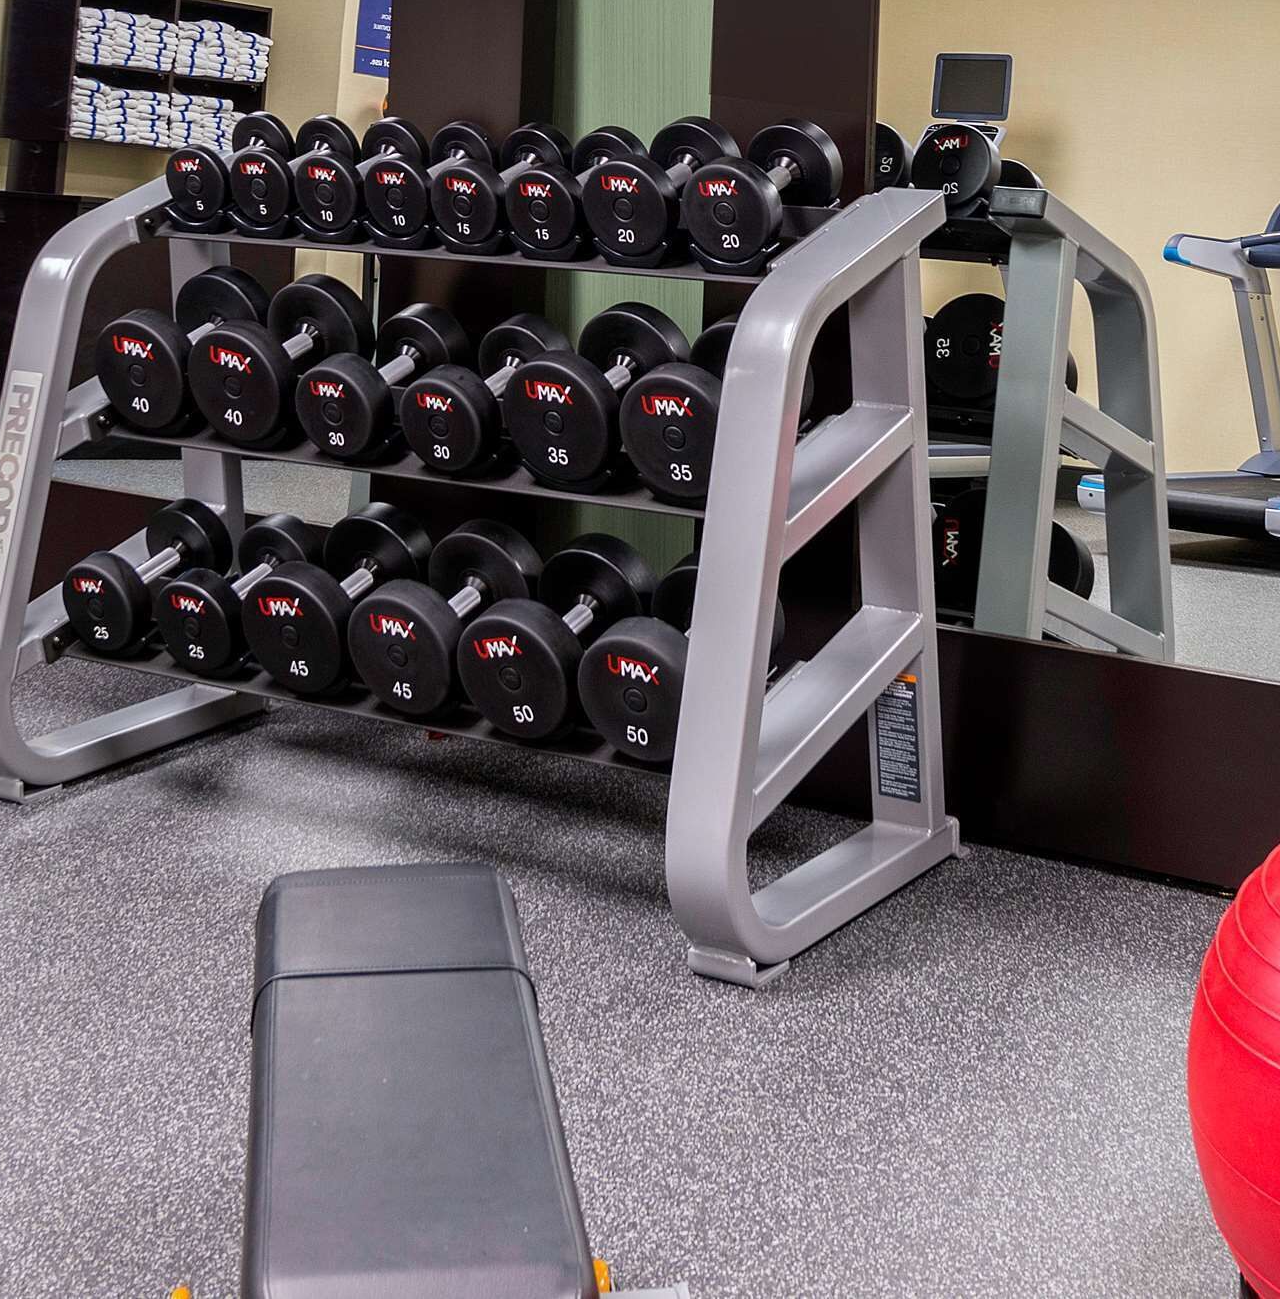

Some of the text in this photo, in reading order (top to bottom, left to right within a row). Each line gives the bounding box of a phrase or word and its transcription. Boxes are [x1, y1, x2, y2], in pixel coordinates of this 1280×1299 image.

[307, 166, 337, 183] UMAX
[375, 171, 407, 185] UMAX
[444, 177, 478, 197] UMAX
[519, 182, 552, 199] UMAX
[600, 174, 641, 195] UMAX
[697, 178, 739, 198] UMAX
[195, 200, 205, 212] 5
[259, 204, 268, 216] 5
[319, 209, 334, 222] 10
[391, 214, 406, 227] 10
[456, 221, 471, 236] 15
[534, 227, 550, 241] 15
[617, 228, 635, 244] 20
[721, 233, 740, 249] 20
[111, 334, 156, 361] UMAX
[209, 344, 253, 375] UMAX
[309, 380, 346, 398] UMAX
[524, 379, 574, 406] UMAX
[131, 396, 150, 413] 40
[415, 392, 454, 413] UMAX
[640, 394, 695, 418] UMAX
[223, 408, 243, 426] 40
[328, 431, 345, 447] 30
[432, 444, 450, 460] 30
[547, 446, 569, 466] 35
[669, 463, 693, 482] 35
[71, 577, 105, 595] UMAX
[170, 593, 207, 616] UMAX
[257, 597, 305, 618] UMAX
[93, 625, 110, 640] 25
[369, 612, 417, 642] UMAX
[188, 644, 205, 659] 25
[472, 635, 524, 660] UMAX
[289, 660, 310, 677] 45
[607, 653, 661, 686] UMAX
[392, 680, 413, 700] 45
[512, 704, 535, 724] 50
[626, 725, 649, 746] 50
